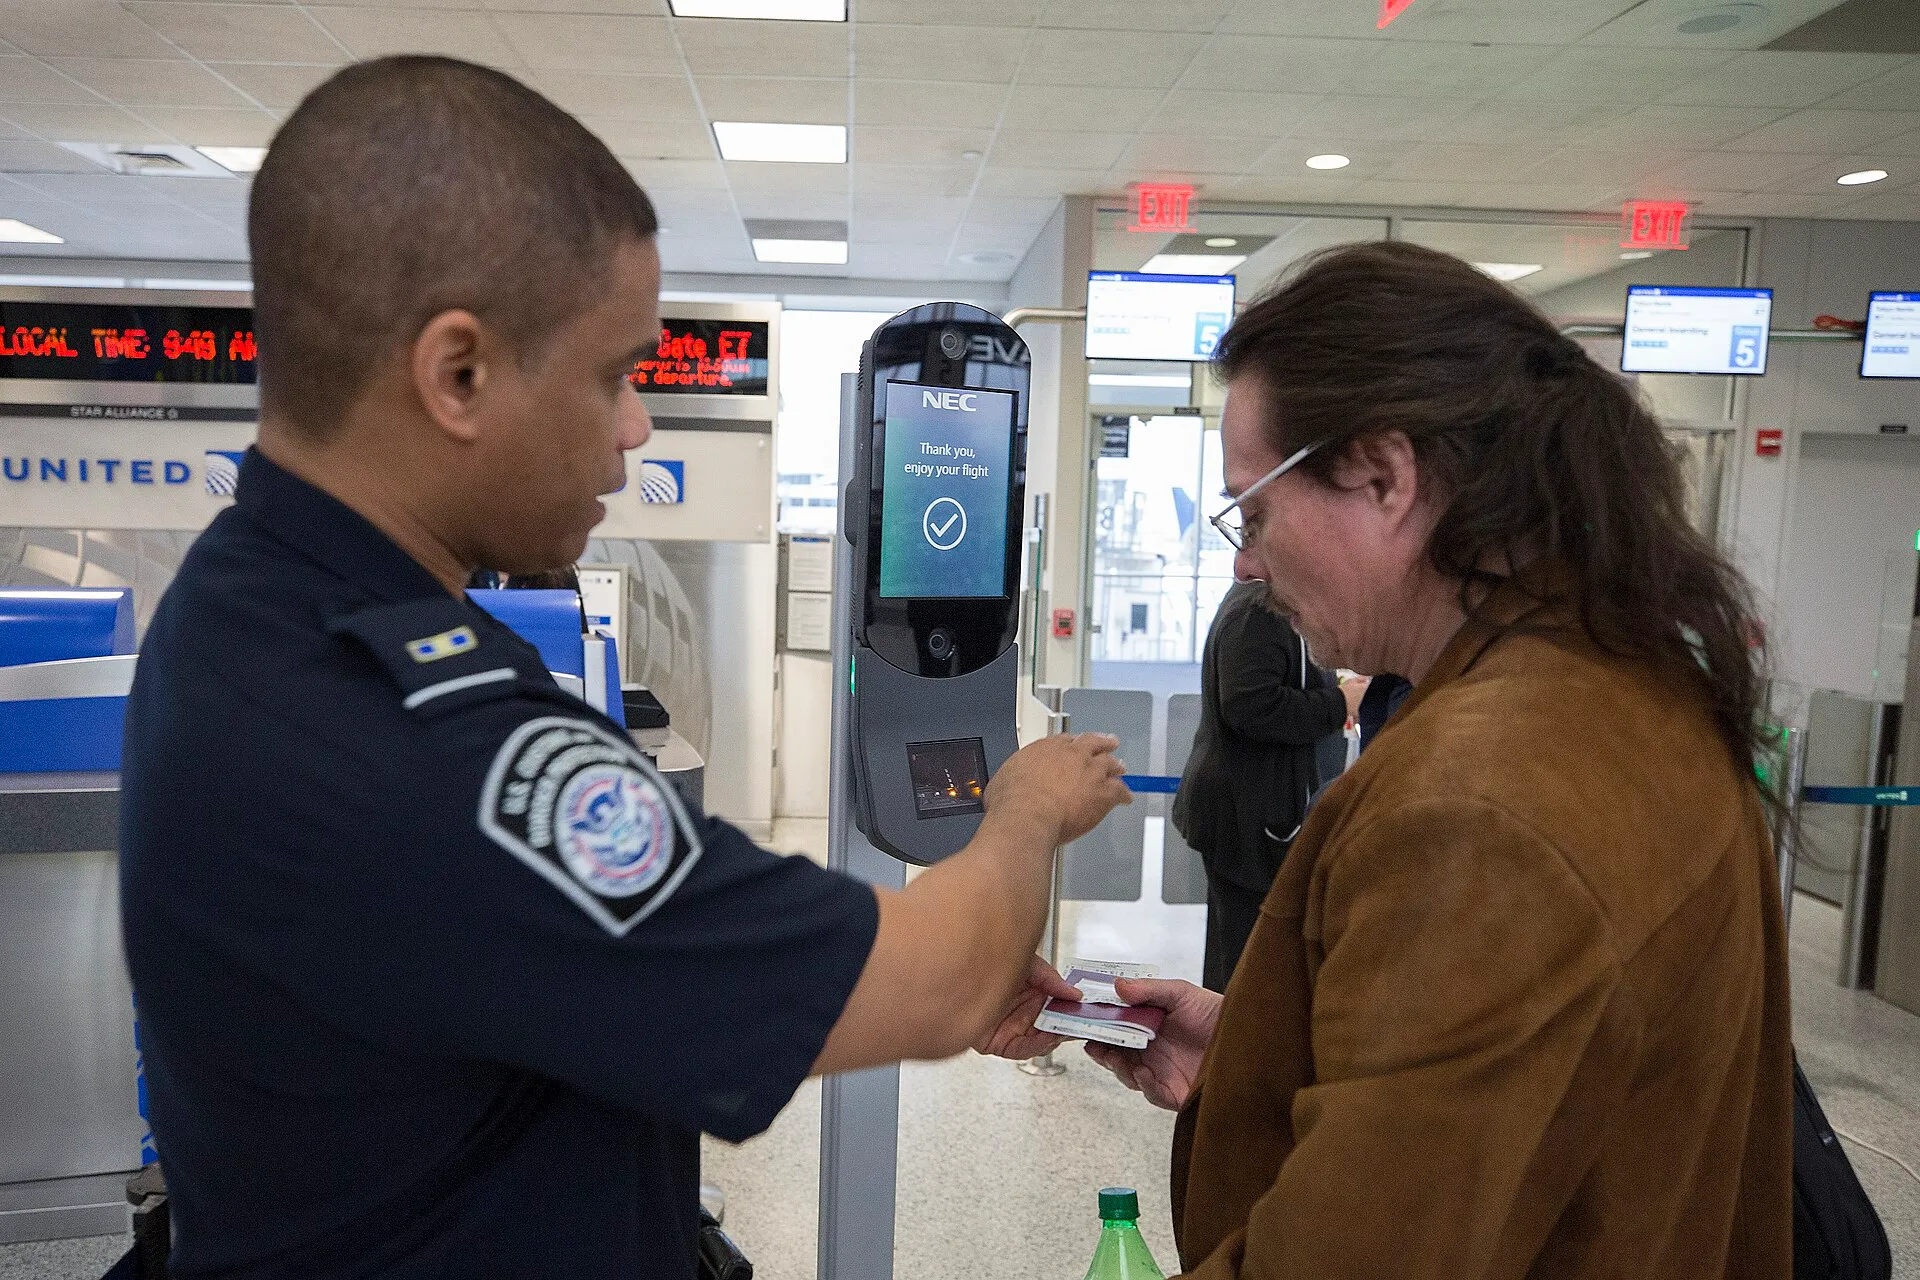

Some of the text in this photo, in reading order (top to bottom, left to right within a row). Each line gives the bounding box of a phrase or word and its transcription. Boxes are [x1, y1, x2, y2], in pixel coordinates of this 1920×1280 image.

[1138, 190, 1191, 226] EXIT
[1631, 207, 1686, 245] EXIT
[0, 326, 78, 357] LOCAL
[657, 328, 752, 360] Gate E7
[1198, 325, 1219, 354] 5
[1734, 338, 1756, 368] 5
[70, 405, 166, 420] STAR ALLIANCE
[922, 390, 977, 412] NEC
[919, 442, 976, 460] Thank you,
[3, 457, 192, 485] UNITED
[904, 461, 989, 480] enjoy your flight
